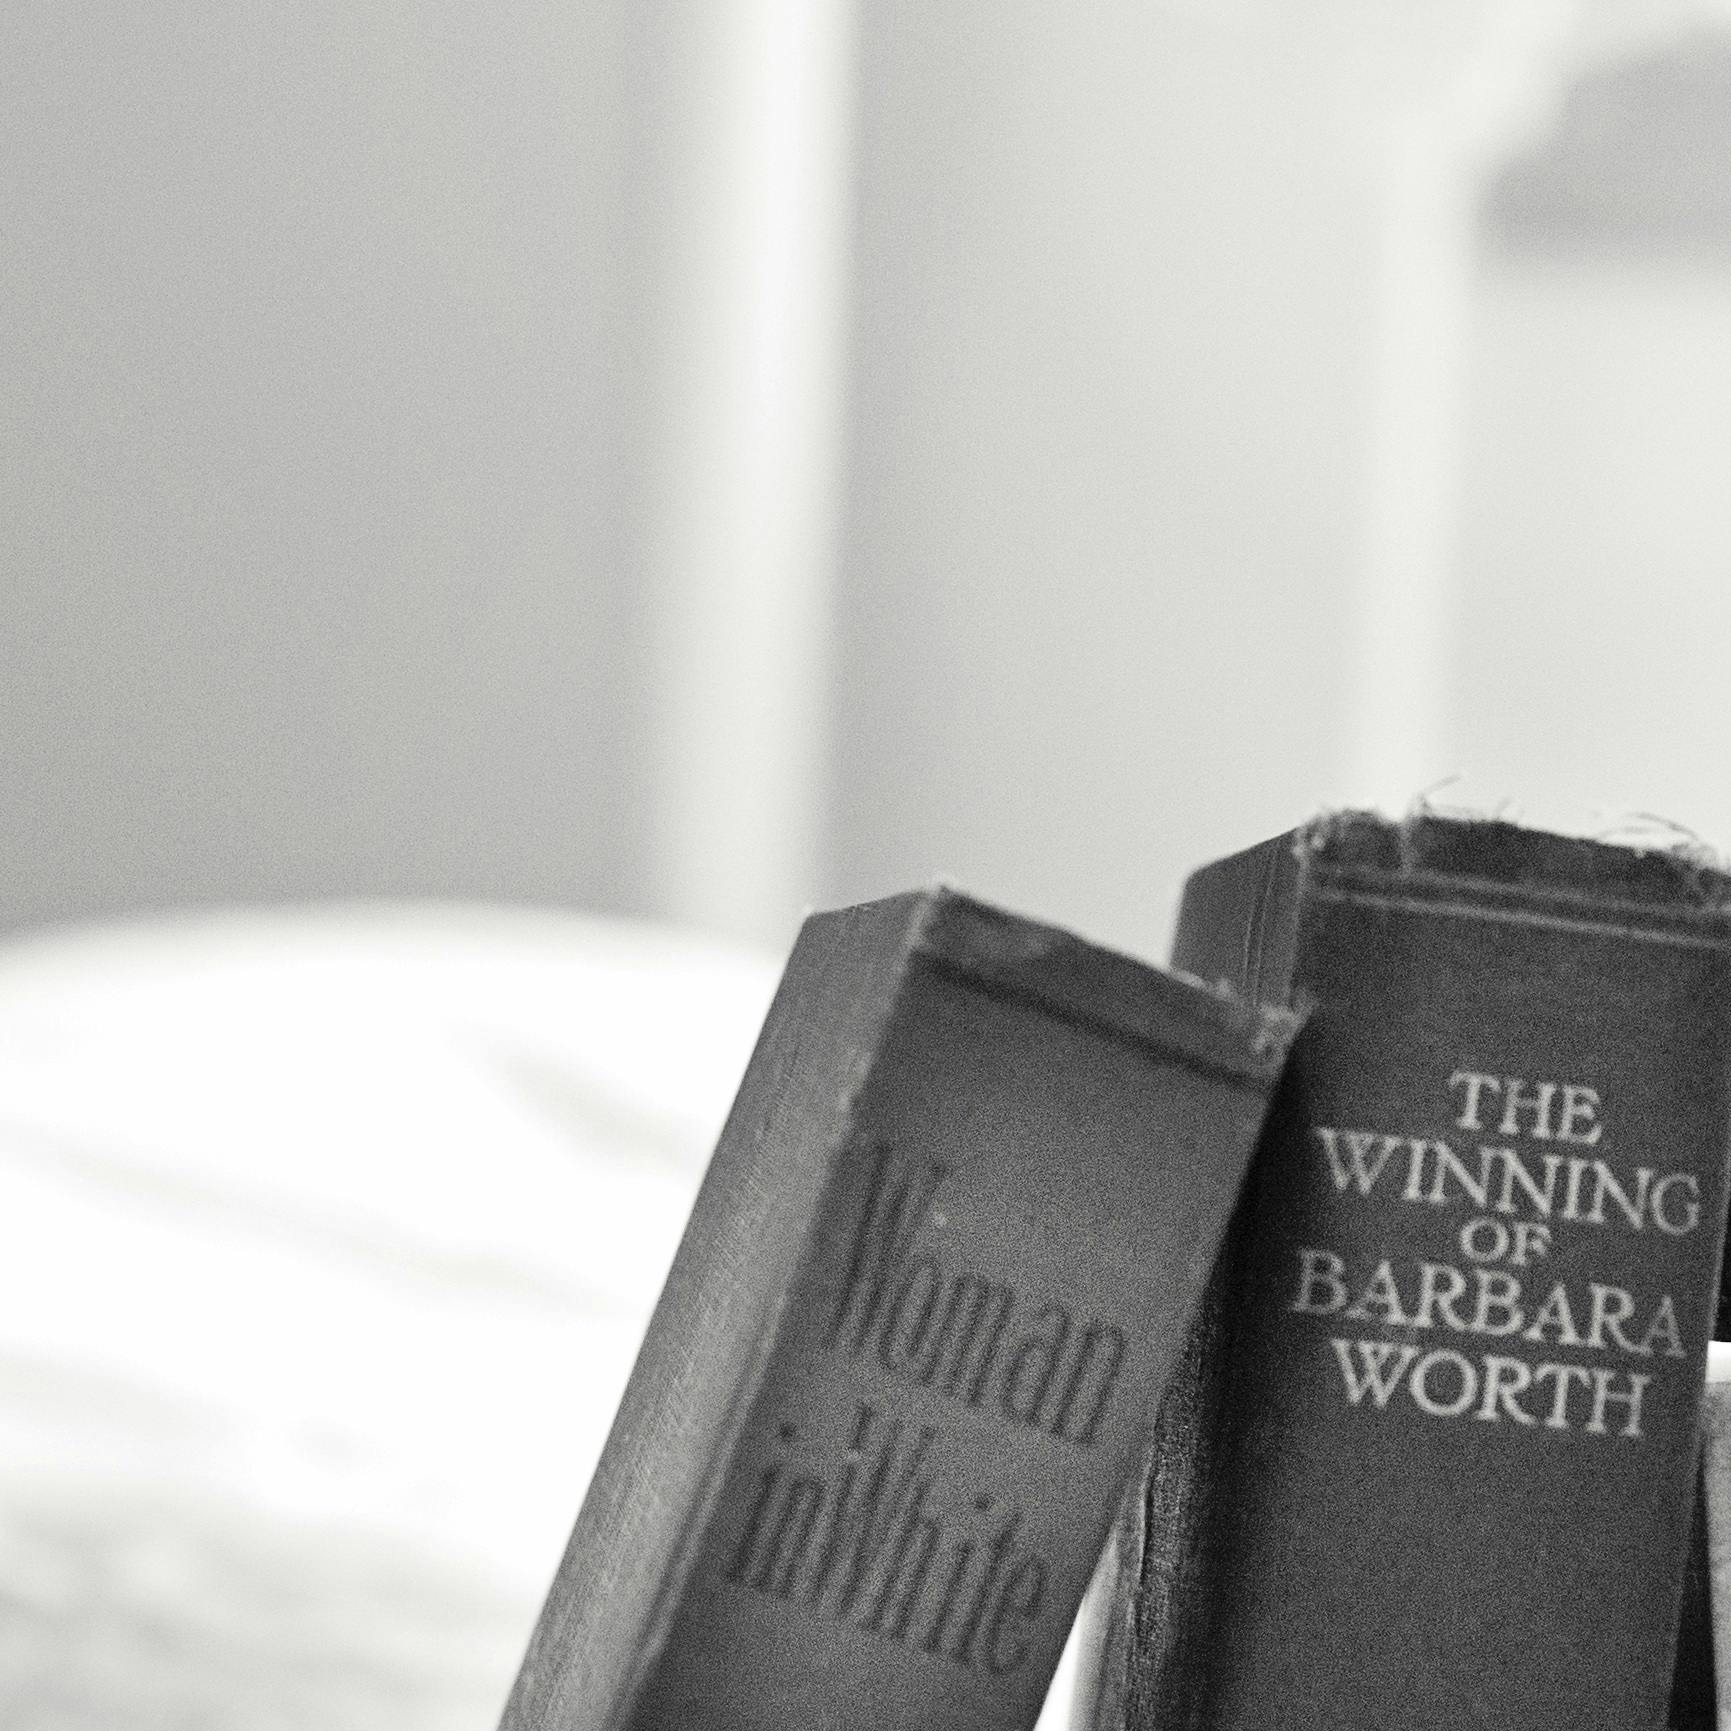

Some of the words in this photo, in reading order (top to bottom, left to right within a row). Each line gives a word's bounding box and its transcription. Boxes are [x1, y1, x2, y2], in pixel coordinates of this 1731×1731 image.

[1449, 1071, 1602, 1146] THE
[1315, 1126, 1701, 1236] WINNING
[824, 1138, 1130, 1448] Woman
[1459, 1217, 1553, 1266] OF
[1293, 1248, 1687, 1359] BARBARA
[1330, 1338, 1652, 1437] WORTH
